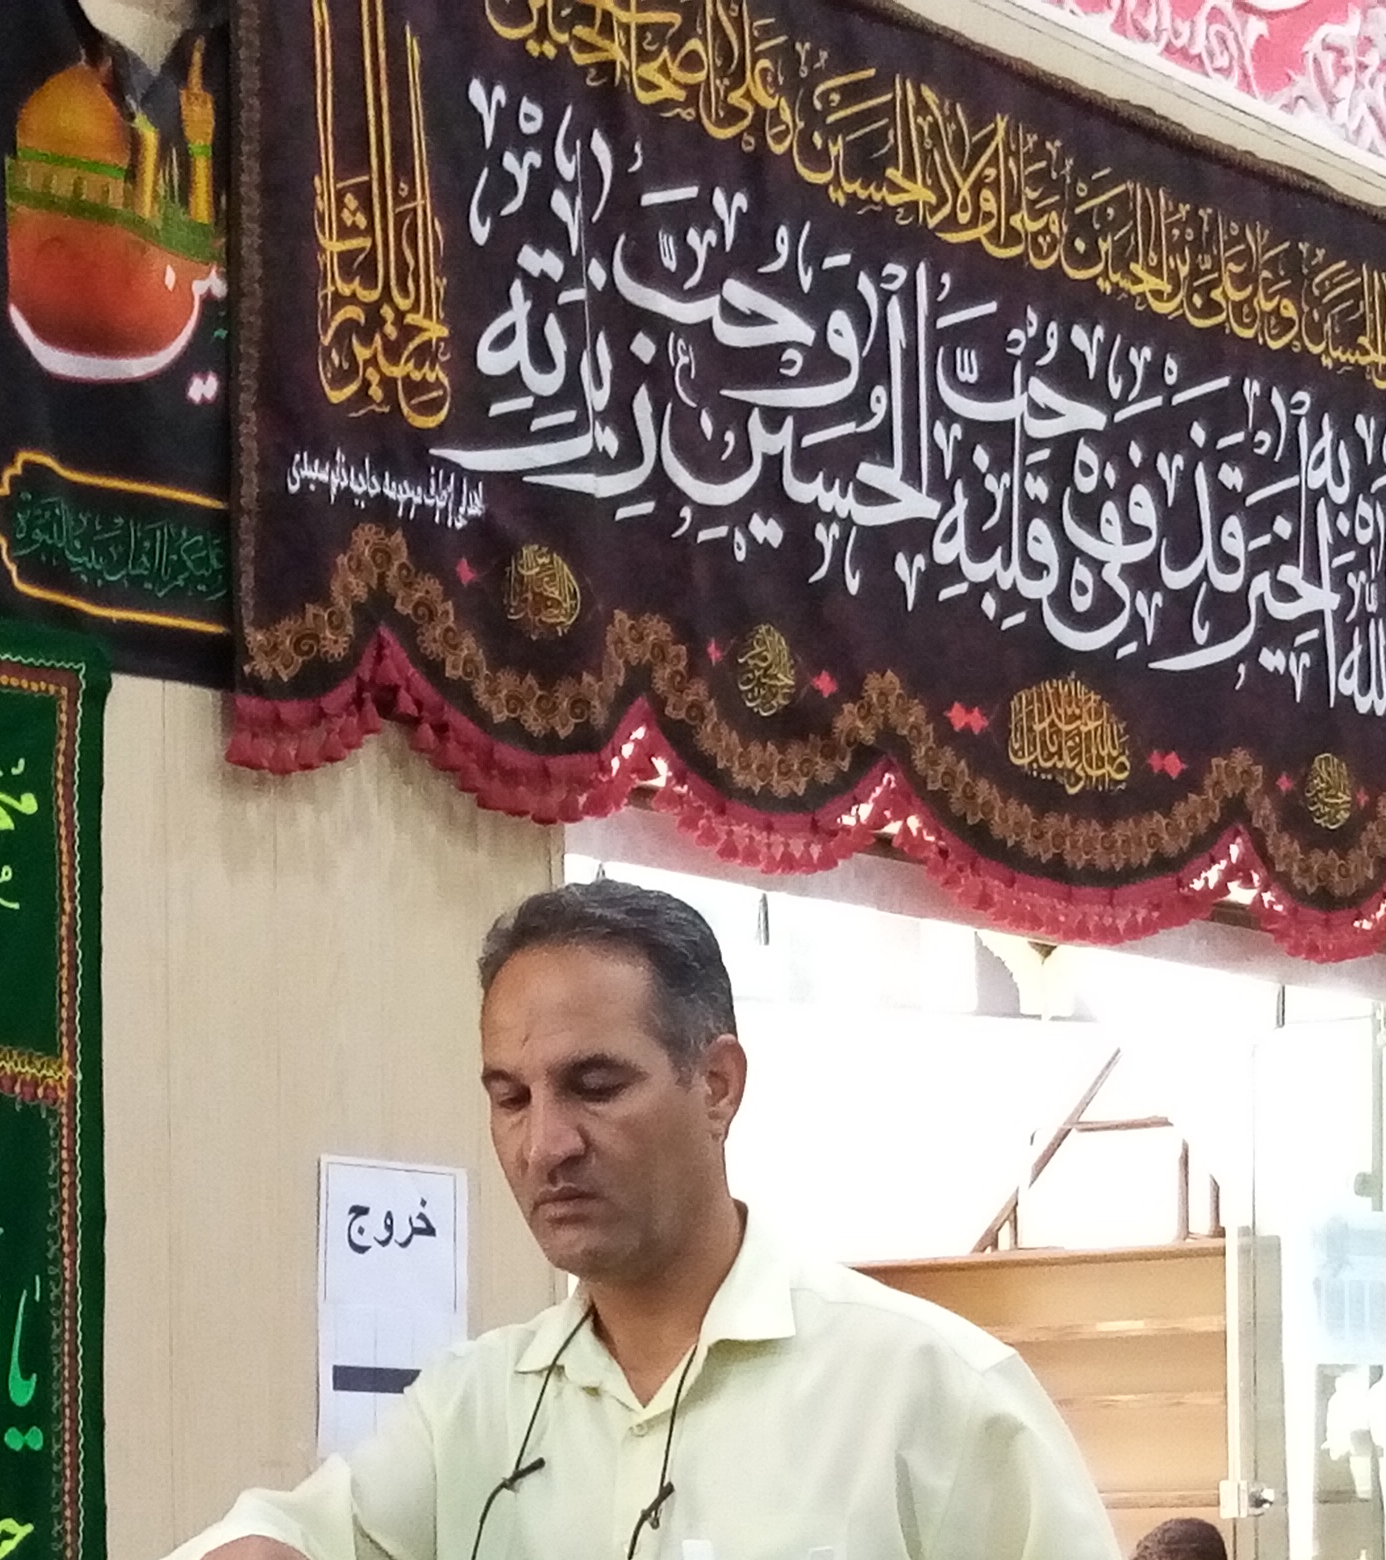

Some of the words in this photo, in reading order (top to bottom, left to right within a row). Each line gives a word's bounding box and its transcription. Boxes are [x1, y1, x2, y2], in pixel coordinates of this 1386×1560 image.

[794, 74, 937, 224] الحسين
[663, 262, 941, 548] الحسين
[346, 1196, 438, 1254] خروج
